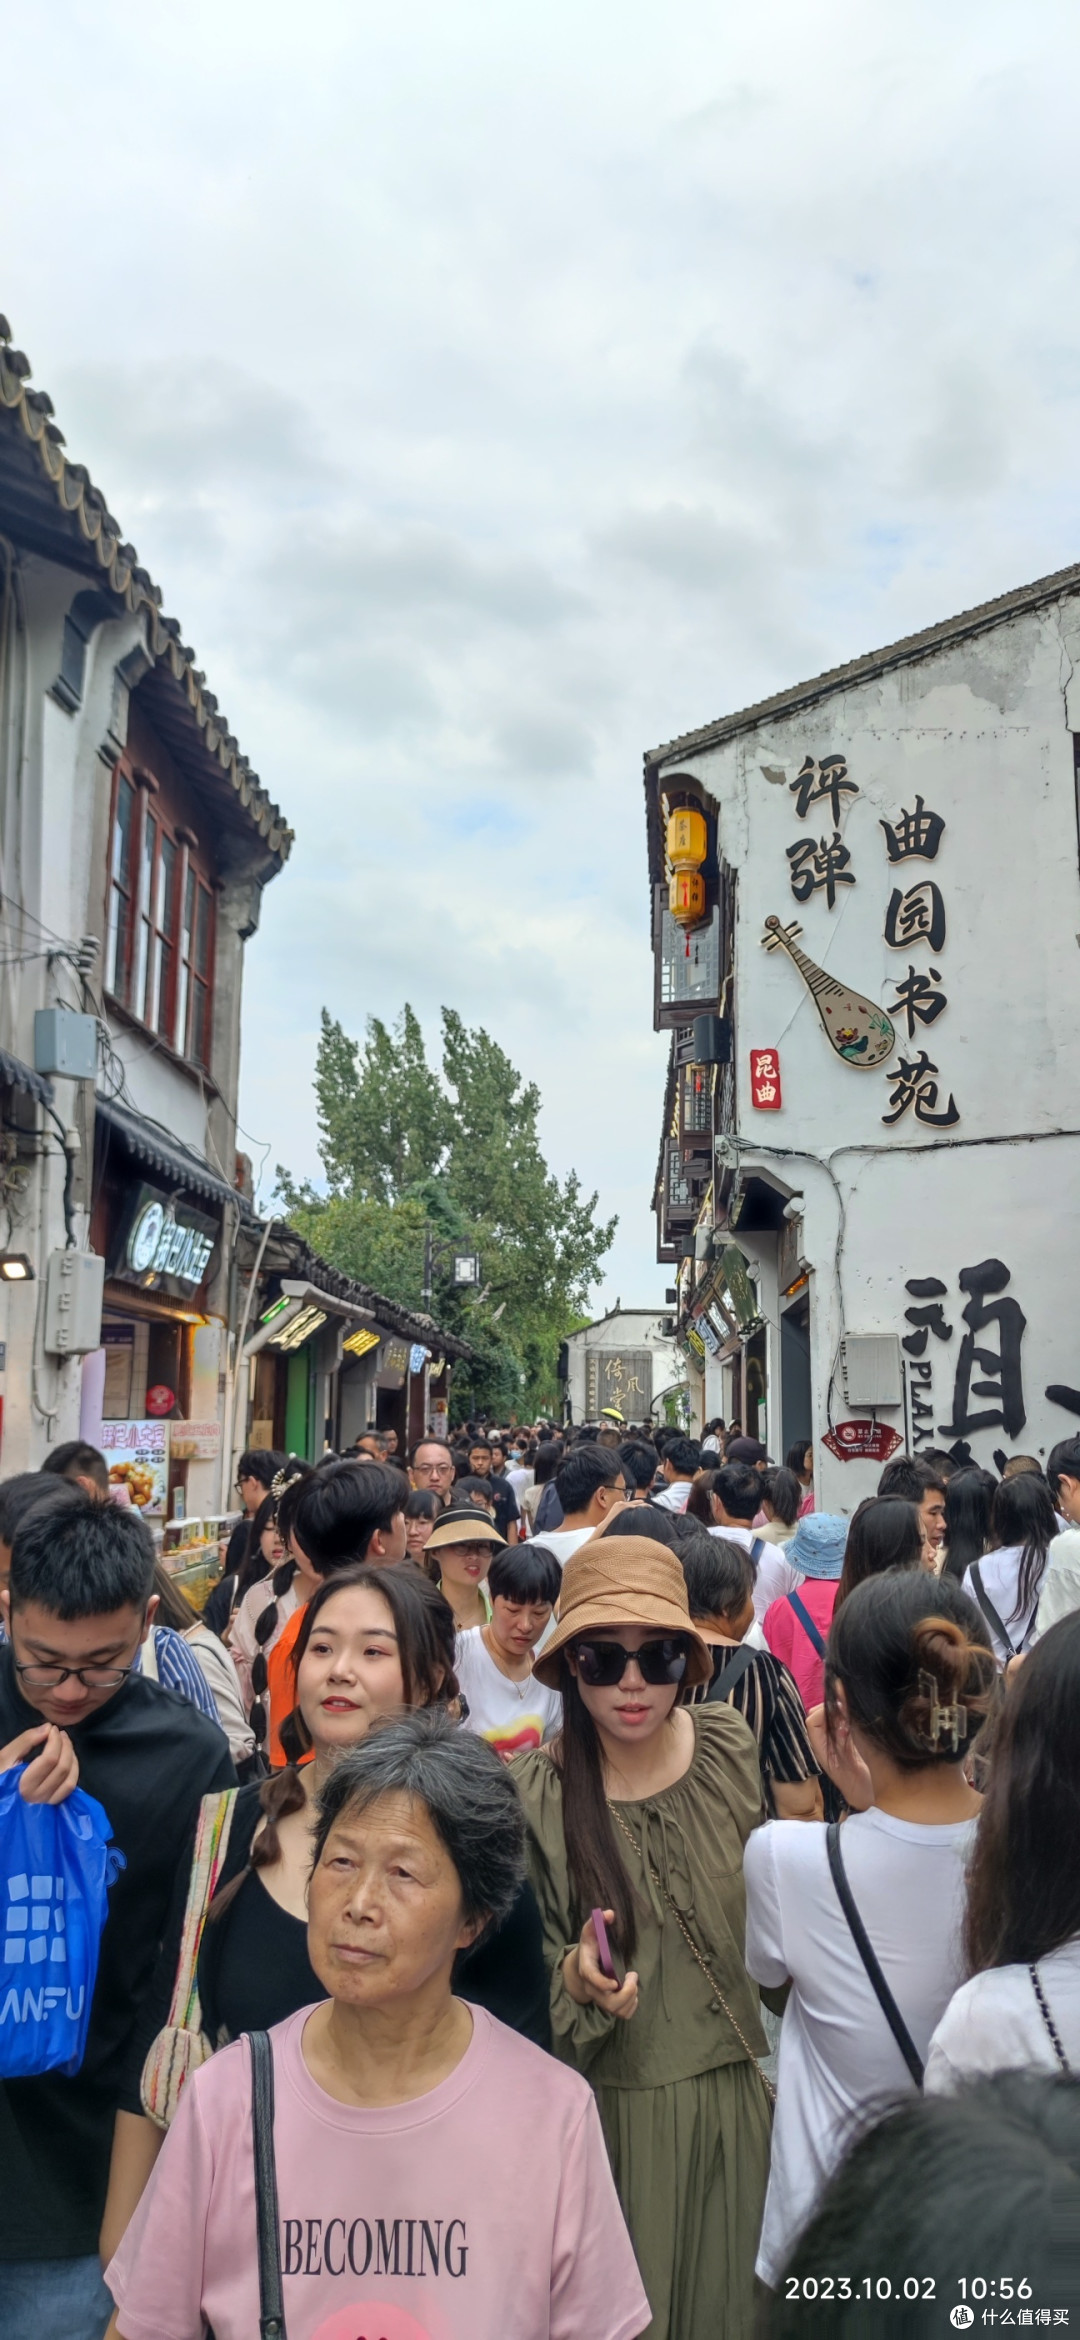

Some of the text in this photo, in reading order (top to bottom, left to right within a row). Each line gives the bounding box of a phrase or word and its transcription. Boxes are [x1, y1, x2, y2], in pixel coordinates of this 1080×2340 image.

[786, 753, 860, 911] 评弹
[879, 794, 961, 1128] 曲园书苑
[755, 1054, 777, 1103] 昆曲
[281, 2217, 469, 2278] BECOMING
